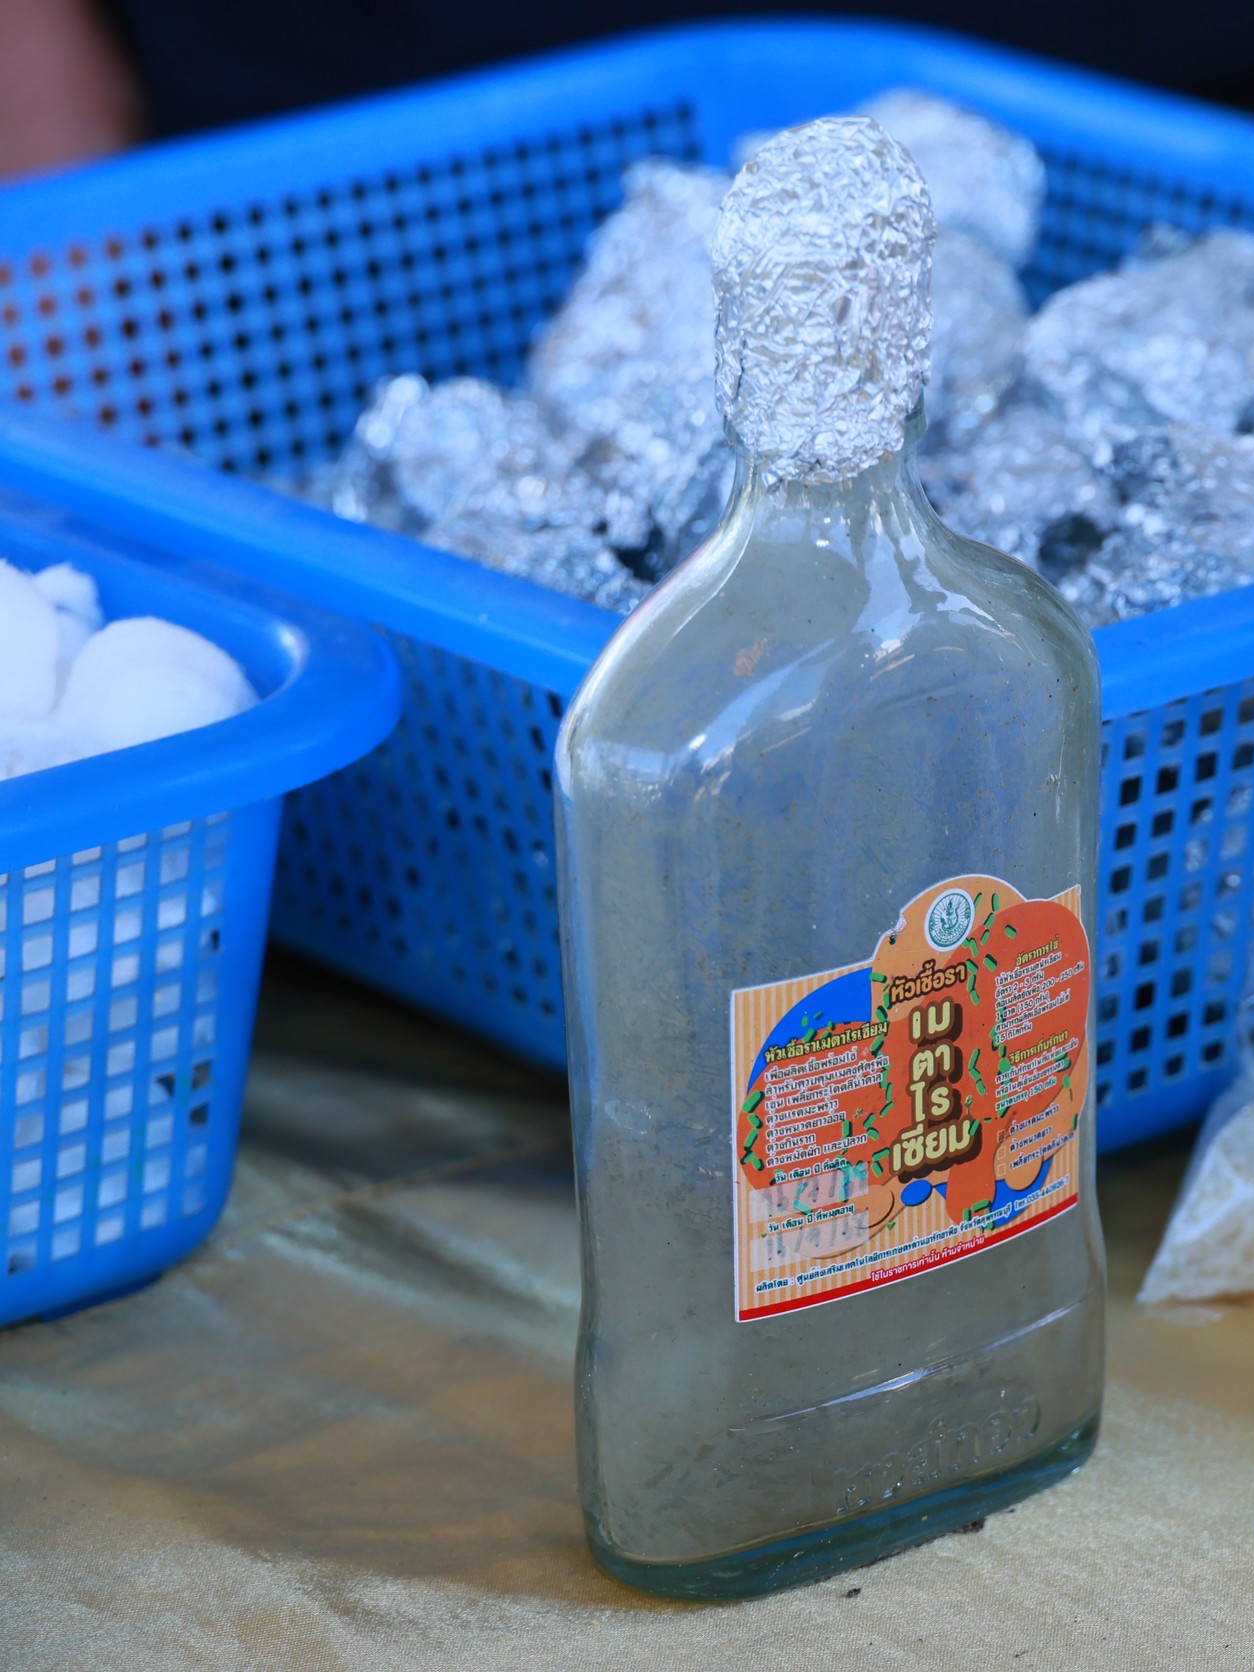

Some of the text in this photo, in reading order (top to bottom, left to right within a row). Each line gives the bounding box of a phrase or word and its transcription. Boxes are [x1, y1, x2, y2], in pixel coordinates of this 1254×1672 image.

[1016, 934, 1059, 966] อัตราการใช้
[890, 958, 967, 1006] หัวเชื้อรา
[1013, 982, 1019, 991] 2
[1041, 978, 1055, 990] 200
[1060, 969, 1073, 982] 250
[912, 1001, 951, 1039] เม
[764, 1021, 888, 1062] หัวเชื้อราเมตาไรเซียม
[996, 1034, 1006, 1044] 15
[1009, 1030, 1068, 1064] วิธีการเก็บรักษา
[765, 1047, 857, 1081] เพื่อผลิตเชื้อพร้อมใช้
[765, 1056, 889, 1096] สำหรับควบคุมแมลงศัตรูพืช
[912, 1043, 951, 1081] ตา
[765, 1073, 883, 1110] เช่น เพลี้ยกระโดดสีน้ำตาล
[909, 1081, 951, 1122] ไร
[1029, 1082, 1043, 1096] 150
[766, 1095, 838, 1124] ด้วงแรดมะพร้าว
[766, 1110, 846, 1138] ด้วงหนวดยาวอ้อย
[766, 1125, 815, 1153] ด้วงกินราก
[766, 1134, 867, 1167] ด้วงหมัดผัก และปลวก
[893, 1118, 971, 1172] เซียม
[790, 1166, 811, 1180] เดือน
[814, 1163, 821, 1174] ปี
[782, 1217, 803, 1230] เดือน
[807, 1213, 813, 1224] ปี
[871, 1235, 985, 1282] ใช้ในราชการเท่านั้น ห้ามจำหน่าย
[756, 1279, 789, 1293] ผลิตโดย
